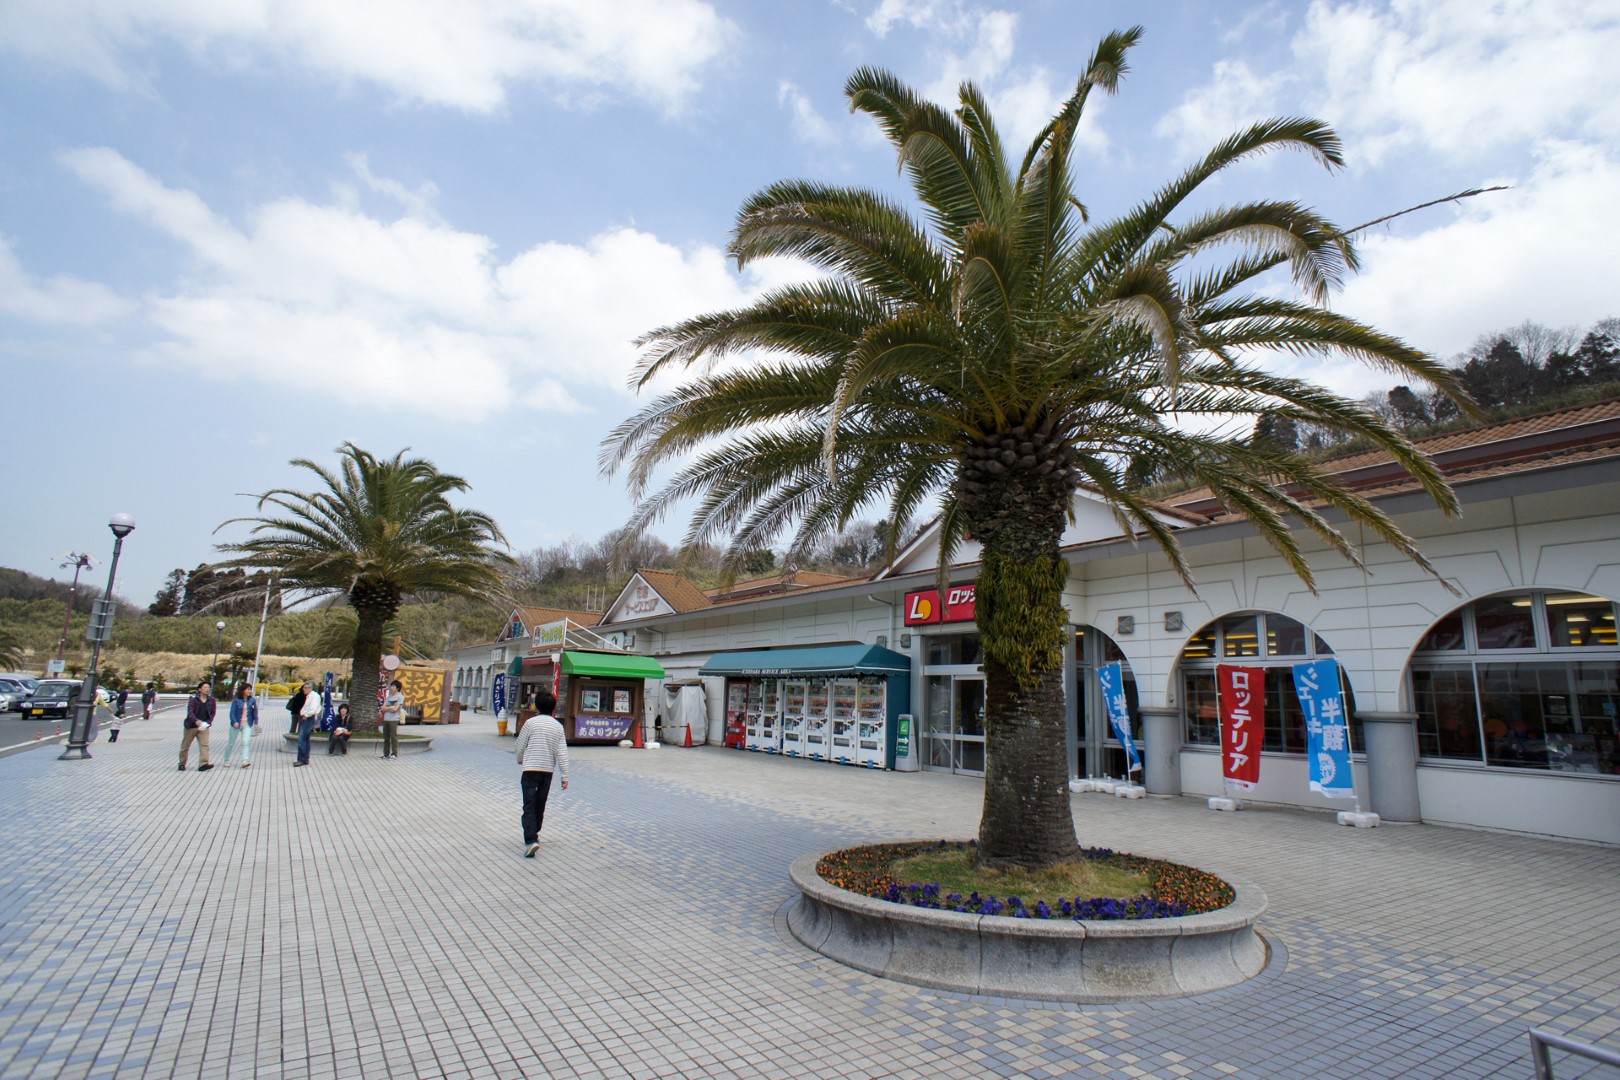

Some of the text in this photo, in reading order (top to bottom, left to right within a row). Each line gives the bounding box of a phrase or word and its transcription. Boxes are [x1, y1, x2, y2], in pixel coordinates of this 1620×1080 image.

[1230, 671, 1252, 773] ロッテリア
